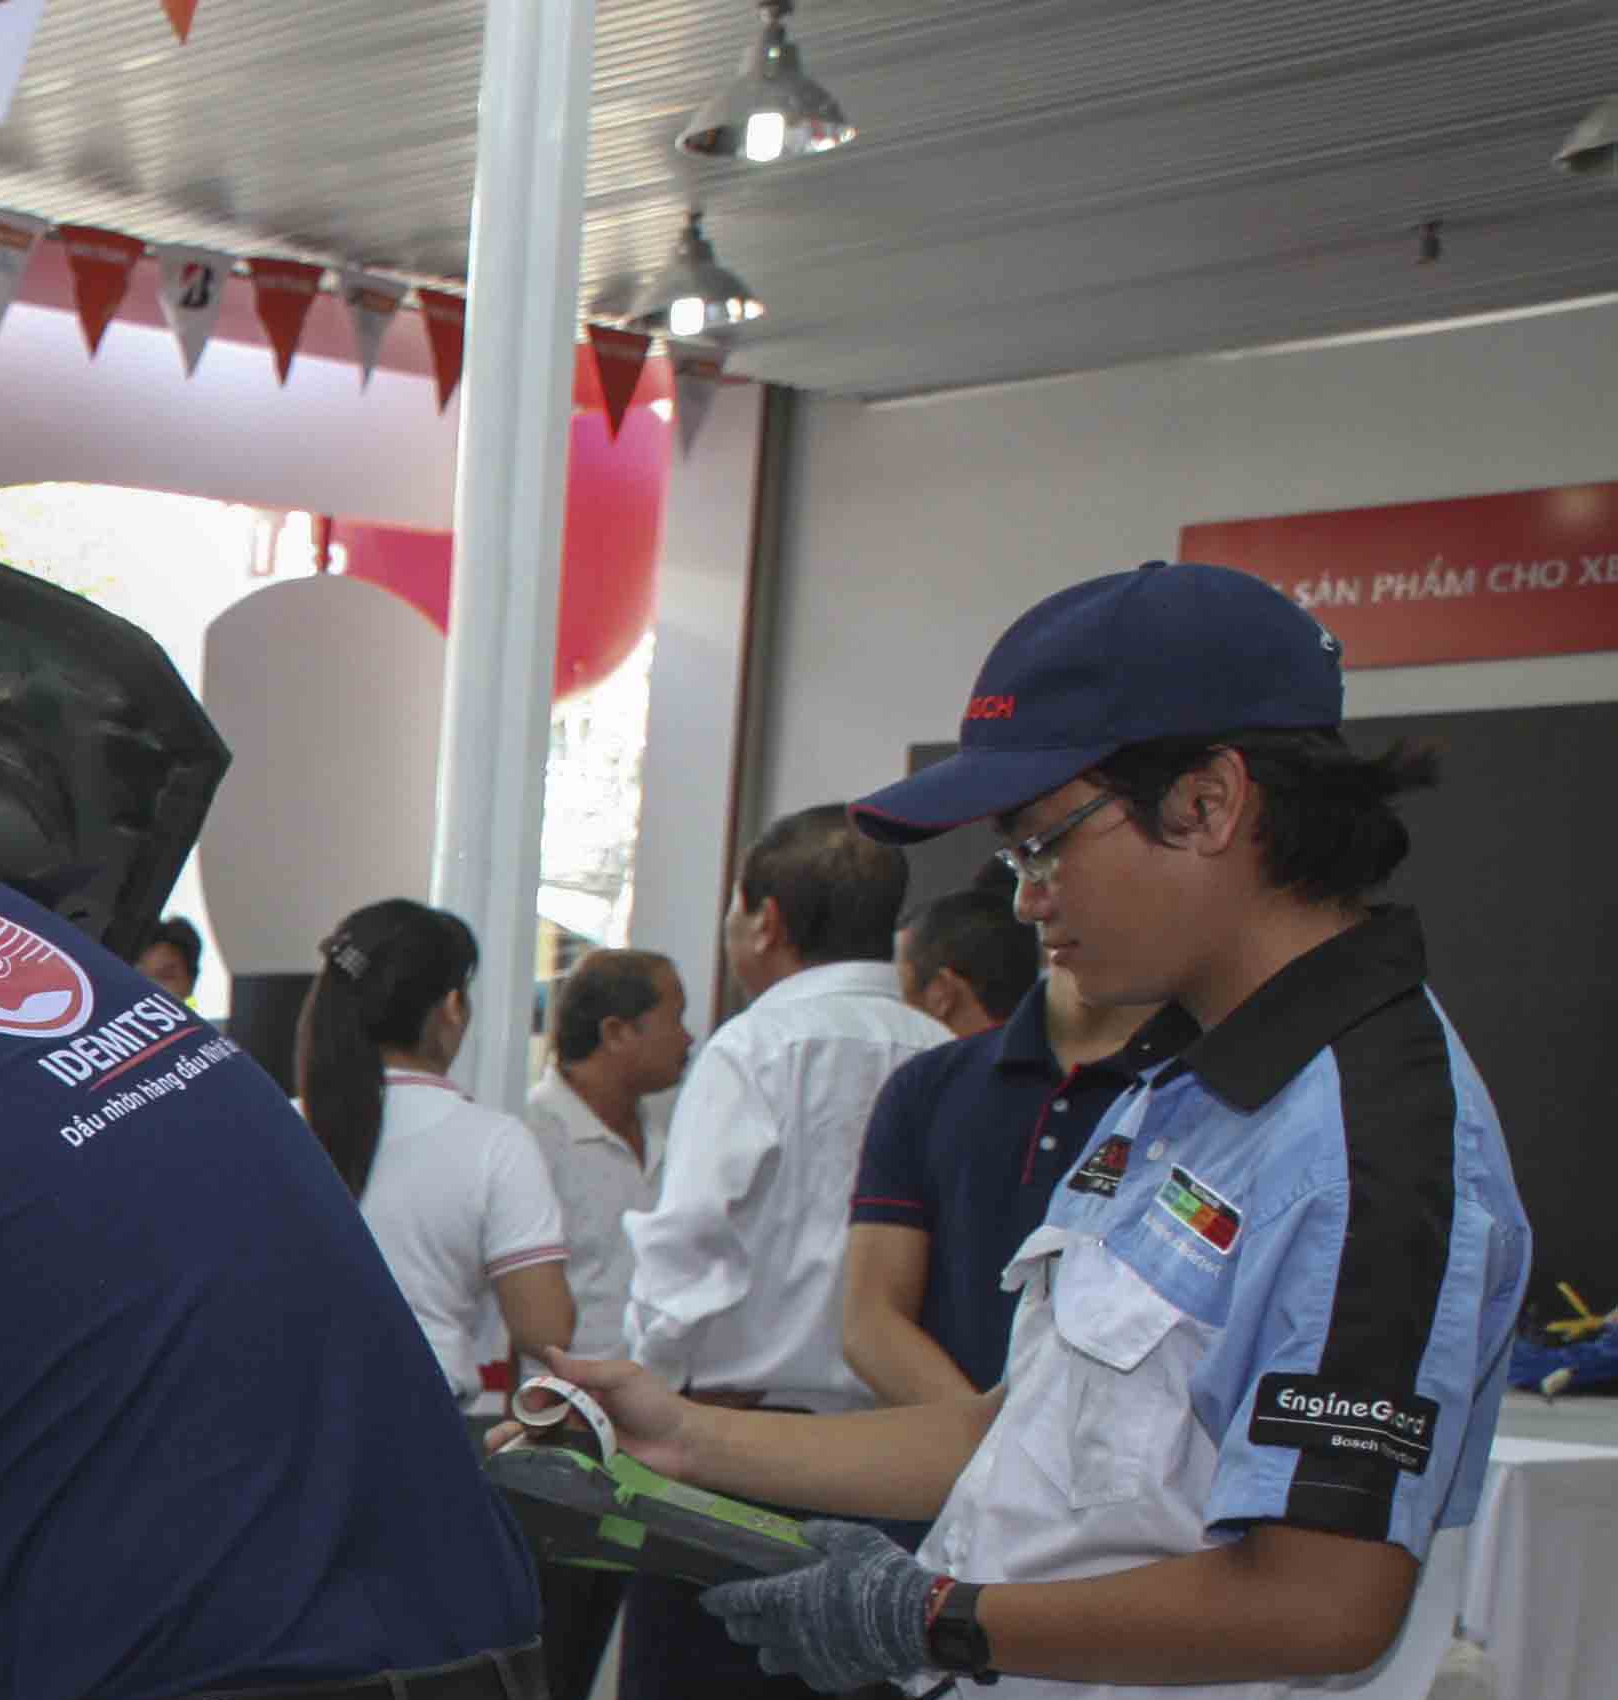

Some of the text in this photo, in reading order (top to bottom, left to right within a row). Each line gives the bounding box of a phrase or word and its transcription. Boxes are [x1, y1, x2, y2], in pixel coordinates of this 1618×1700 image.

[1486, 558, 1569, 592] CHO
[38, 992, 188, 1088] IDEMITSU
[1330, 1434, 1380, 1453] Bosch
